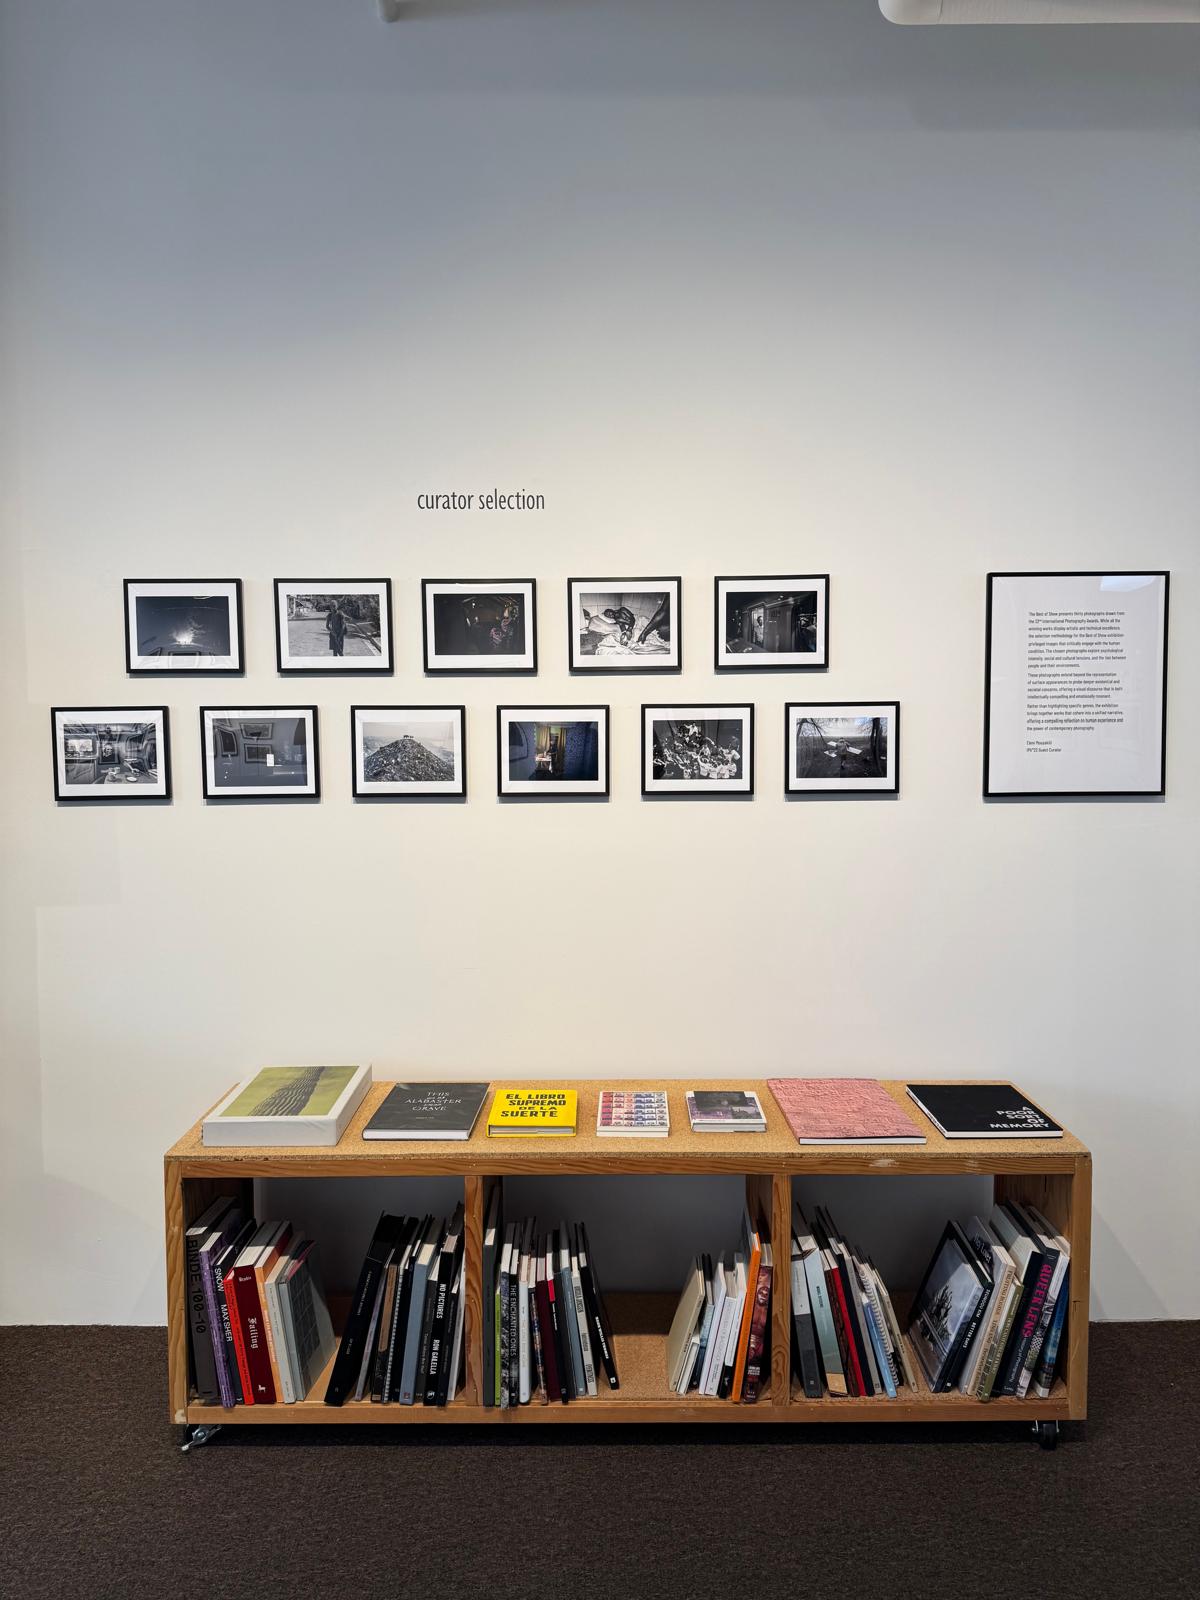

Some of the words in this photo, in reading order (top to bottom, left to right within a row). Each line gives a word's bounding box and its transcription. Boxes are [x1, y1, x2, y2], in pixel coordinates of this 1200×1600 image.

[417, 491, 474, 510] curator
[478, 488, 545, 510] selection
[214, 1267, 224, 1292] SNOW
[439, 1284, 446, 1292] NO
[1032, 1264, 1052, 1311] QUEER
[192, 1289, 206, 1334] 100-10
[220, 1304, 229, 1322] MAX
[436, 1292, 446, 1319] PICTURES
[224, 1322, 232, 1342] SHER
[248, 1317, 258, 1350] Failing
[968, 1322, 976, 1337] BETTER
[1022, 1307, 1038, 1338] LENS
[432, 1340, 440, 1351] RON
[430, 1352, 439, 1375] GALELLA
